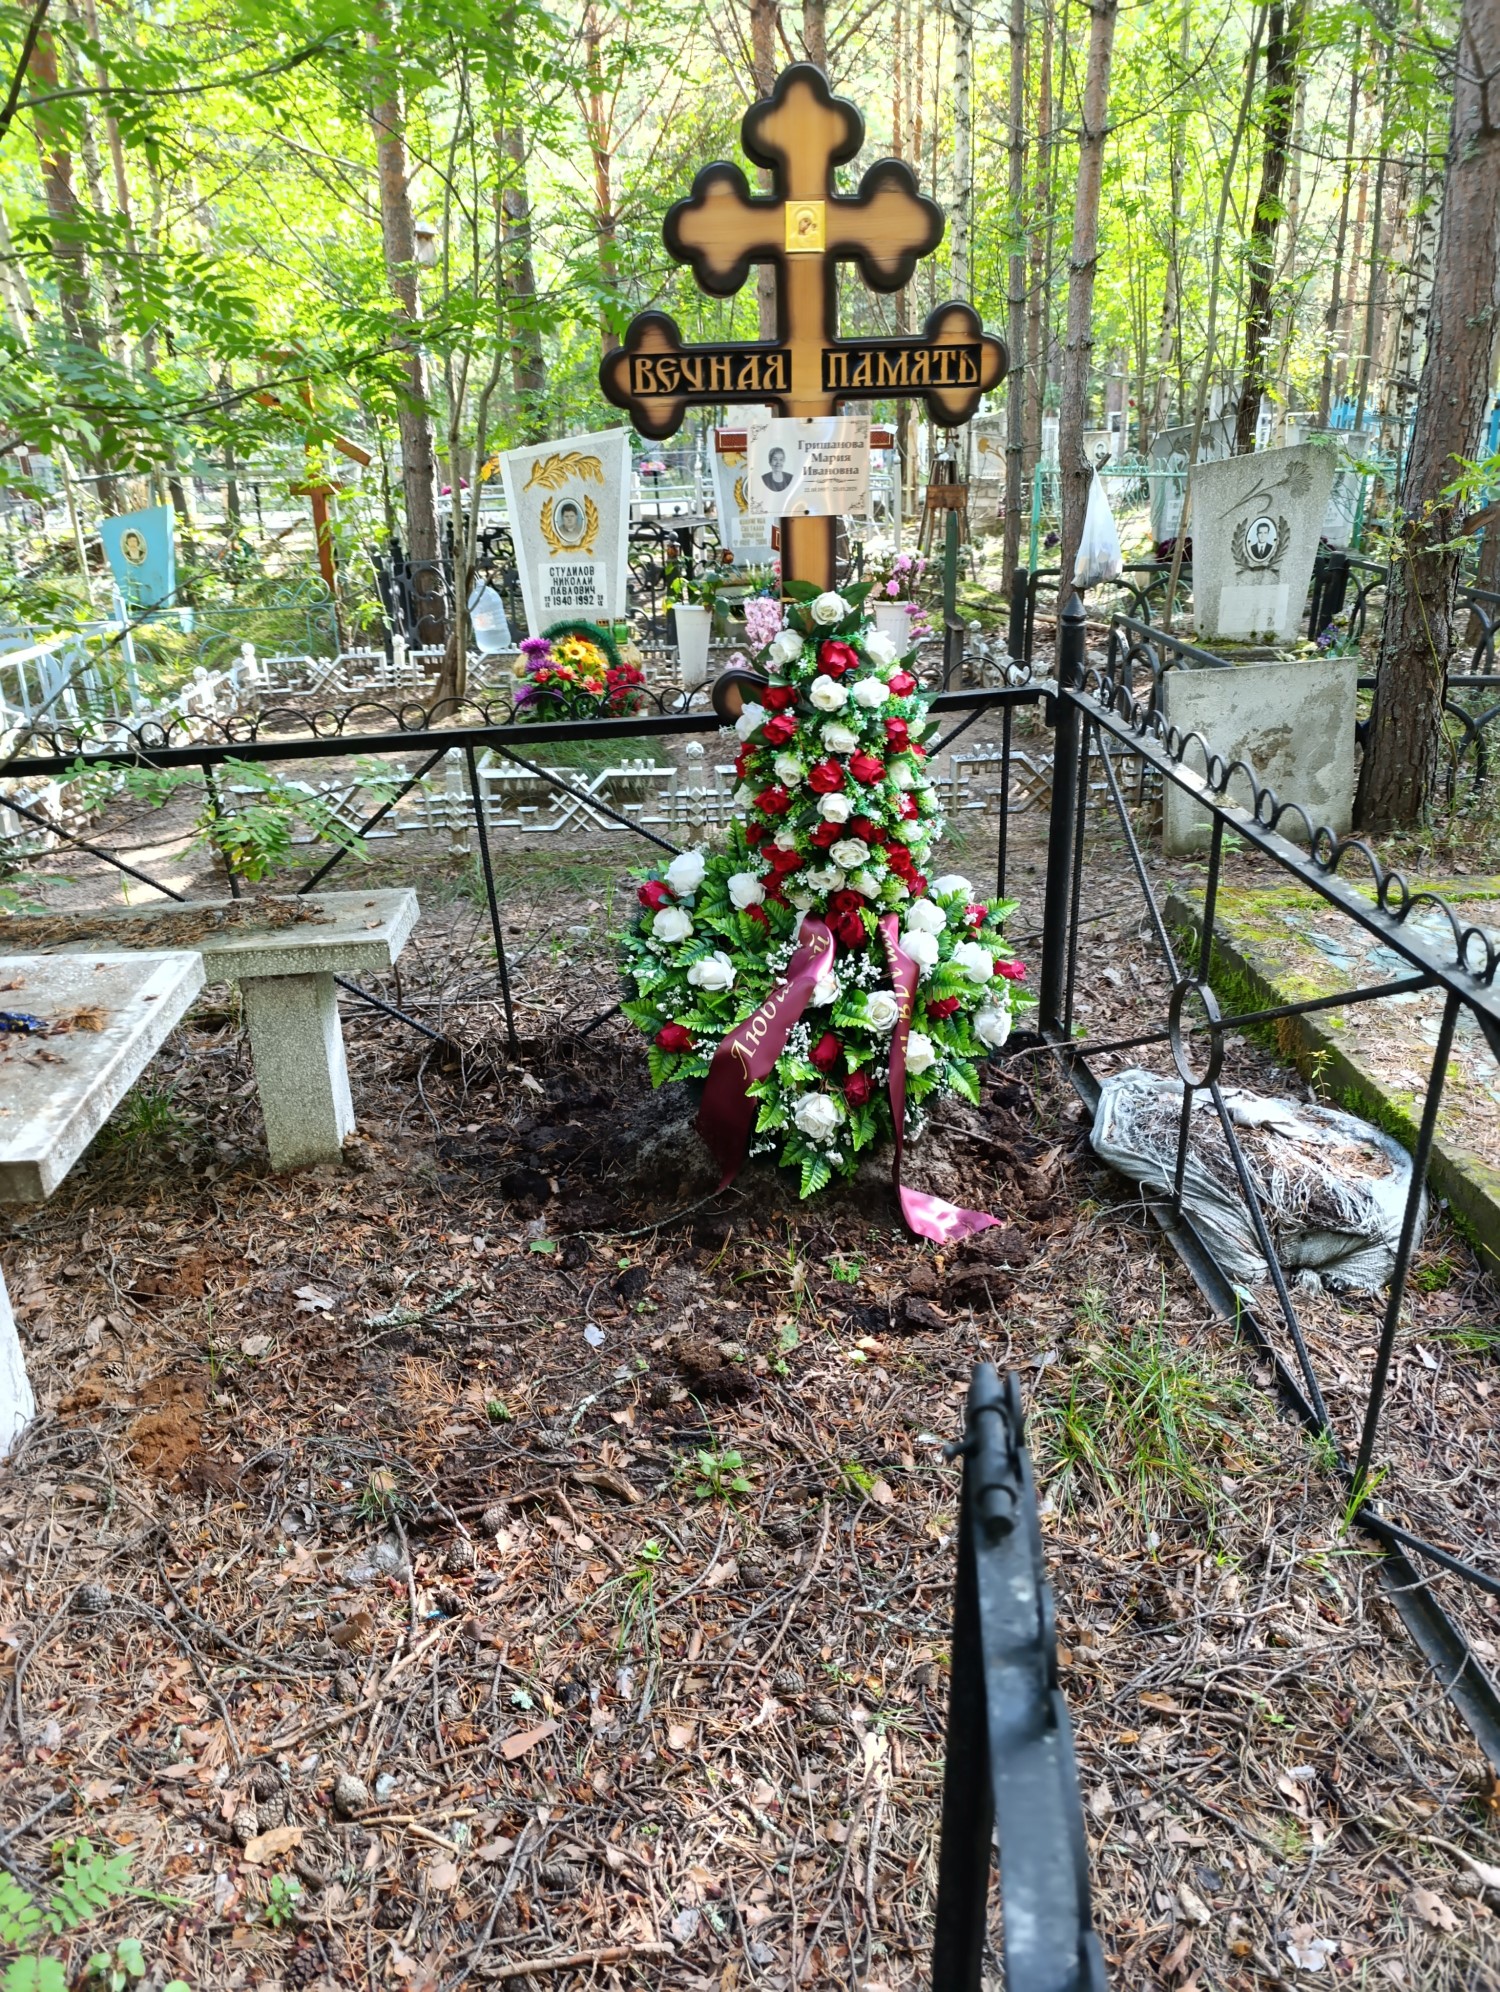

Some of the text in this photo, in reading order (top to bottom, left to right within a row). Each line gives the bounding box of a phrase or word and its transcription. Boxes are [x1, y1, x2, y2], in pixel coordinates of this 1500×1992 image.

[827, 349, 978, 388] ПАМЯТЬ
[798, 440, 864, 452] Гришанова
[811, 453, 851, 464] Мария
[803, 466, 859, 475] Ивановна
[549, 566, 595, 576] СТУДИЛОВ
[550, 586, 595, 595] ПАВЛОВИЧ
